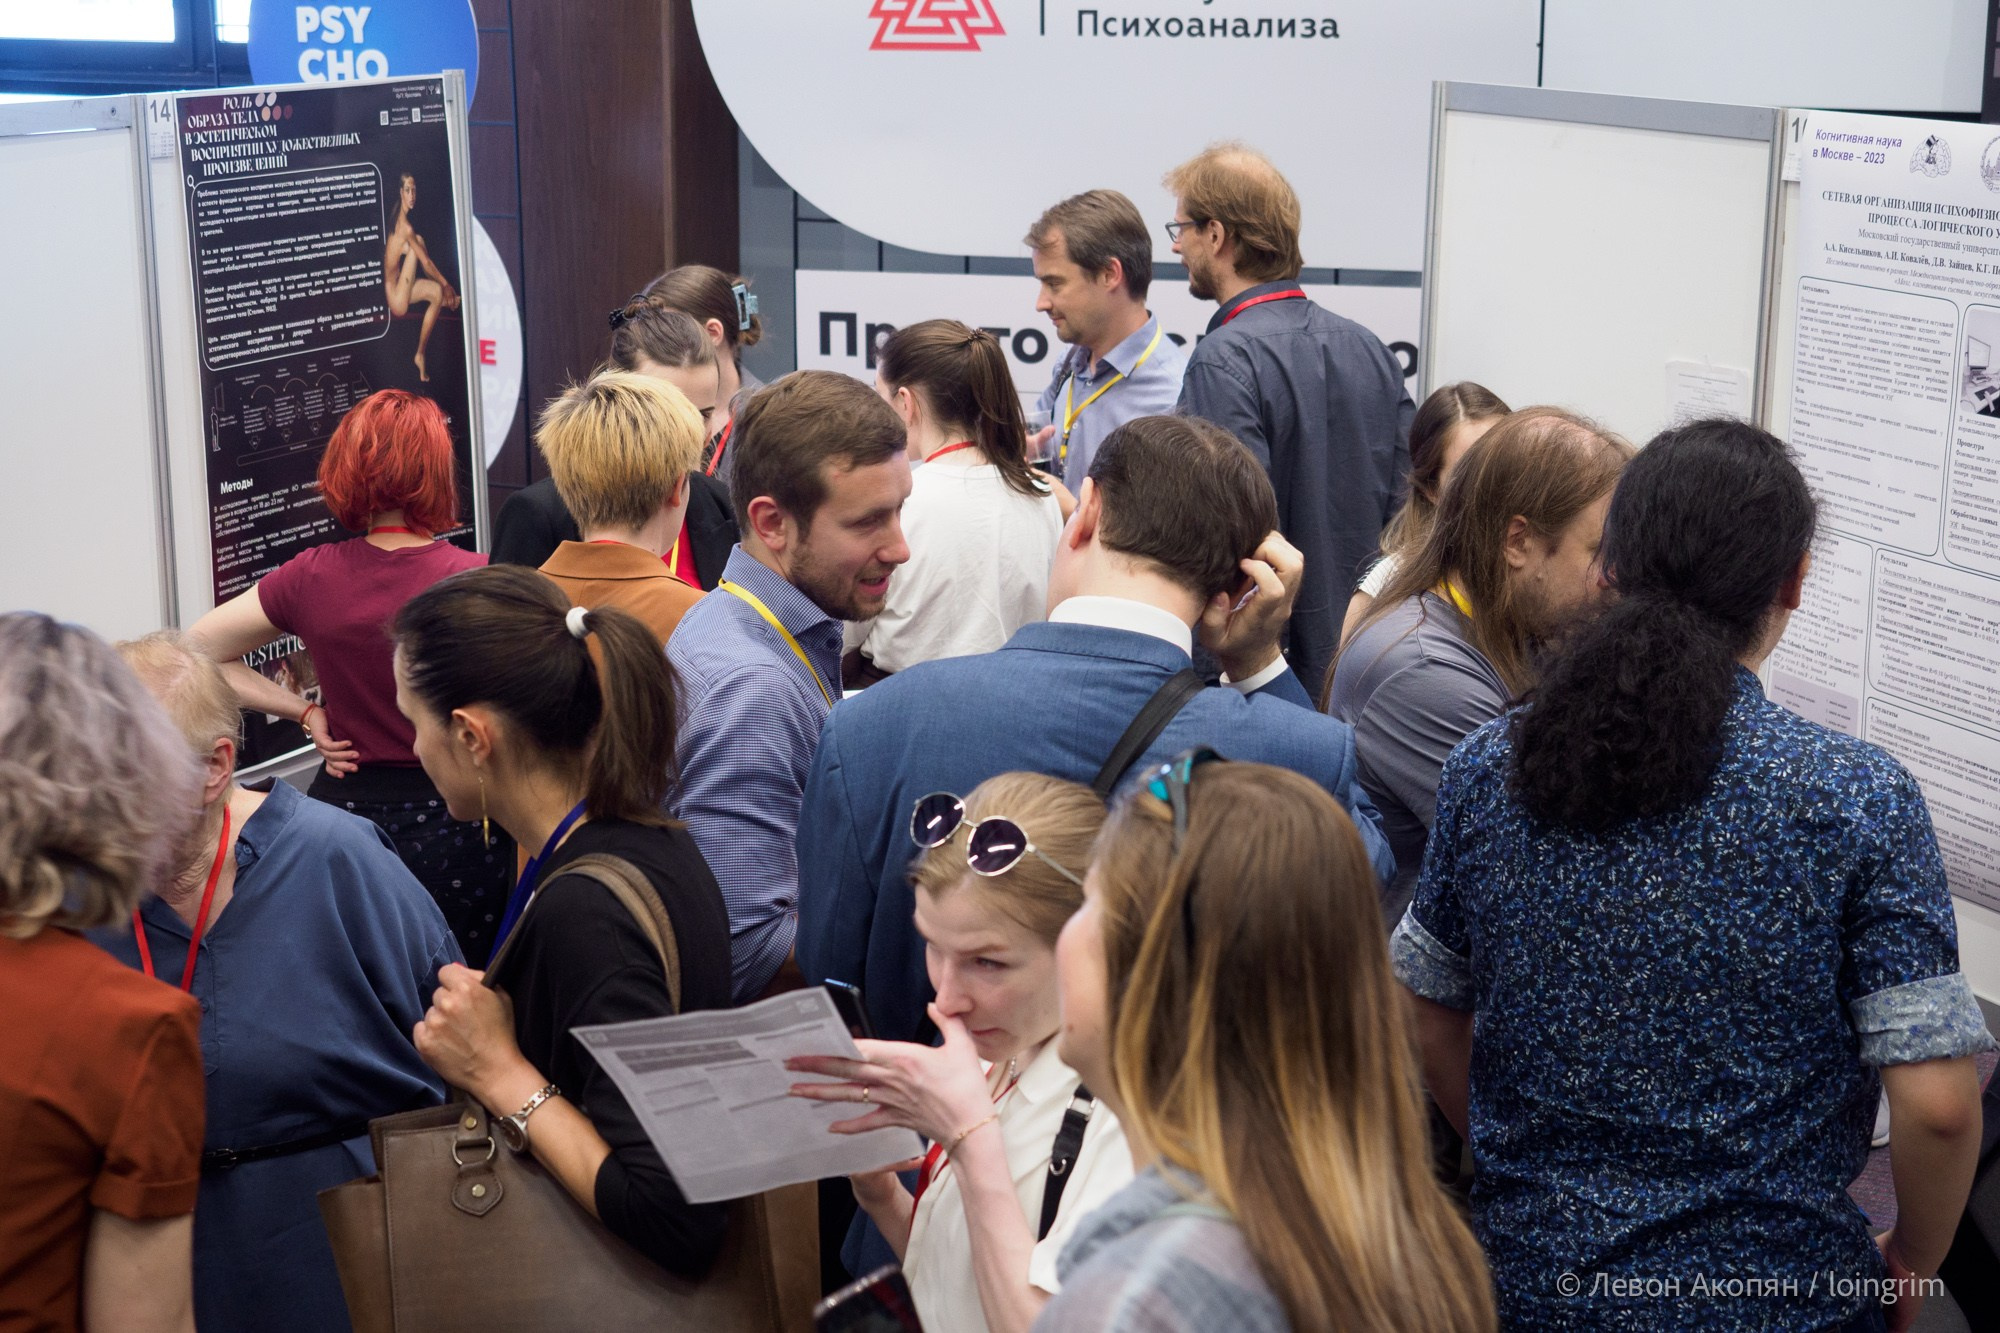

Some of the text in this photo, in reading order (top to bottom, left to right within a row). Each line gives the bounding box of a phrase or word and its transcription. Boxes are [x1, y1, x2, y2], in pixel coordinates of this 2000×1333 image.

[296, 5, 371, 43] PSY
[1077, 9, 1340, 39] Психоанализа
[298, 48, 389, 83] CHO
[150, 98, 171, 123] 14
[222, 95, 252, 110] РОЛЬ
[187, 109, 259, 129] ОБРАЗА ТЕЛА
[1792, 117, 1808, 143] 1
[185, 132, 192, 145] В
[193, 123, 277, 145] ЭСТЕТИЧЕСКОМ
[1815, 129, 1901, 148] Когнитивная наука
[191, 141, 263, 162] ВОСПРИЯТИИ
[1812, 149, 1818, 157] в
[1820, 147, 1853, 160] Москве
[1864, 151, 1884, 163] 2023
[203, 153, 287, 176] ПРОИЗВЕДЕНИЙ
[1822, 190, 1861, 204] СЕТЕВАЯ
[1864, 195, 1931, 213] ОРГАНИЗАЦИЯ
[1868, 212, 1917, 228] ПРОЦЕССА
[1919, 218, 1993, 238] ЛОГИЧЕСКОГО
[1838, 243, 1882, 259] Кисельников,
[1858, 228, 1898, 242] Московский
[1900, 233, 1960, 253] государственный
[220, 477, 253, 494] Методы
